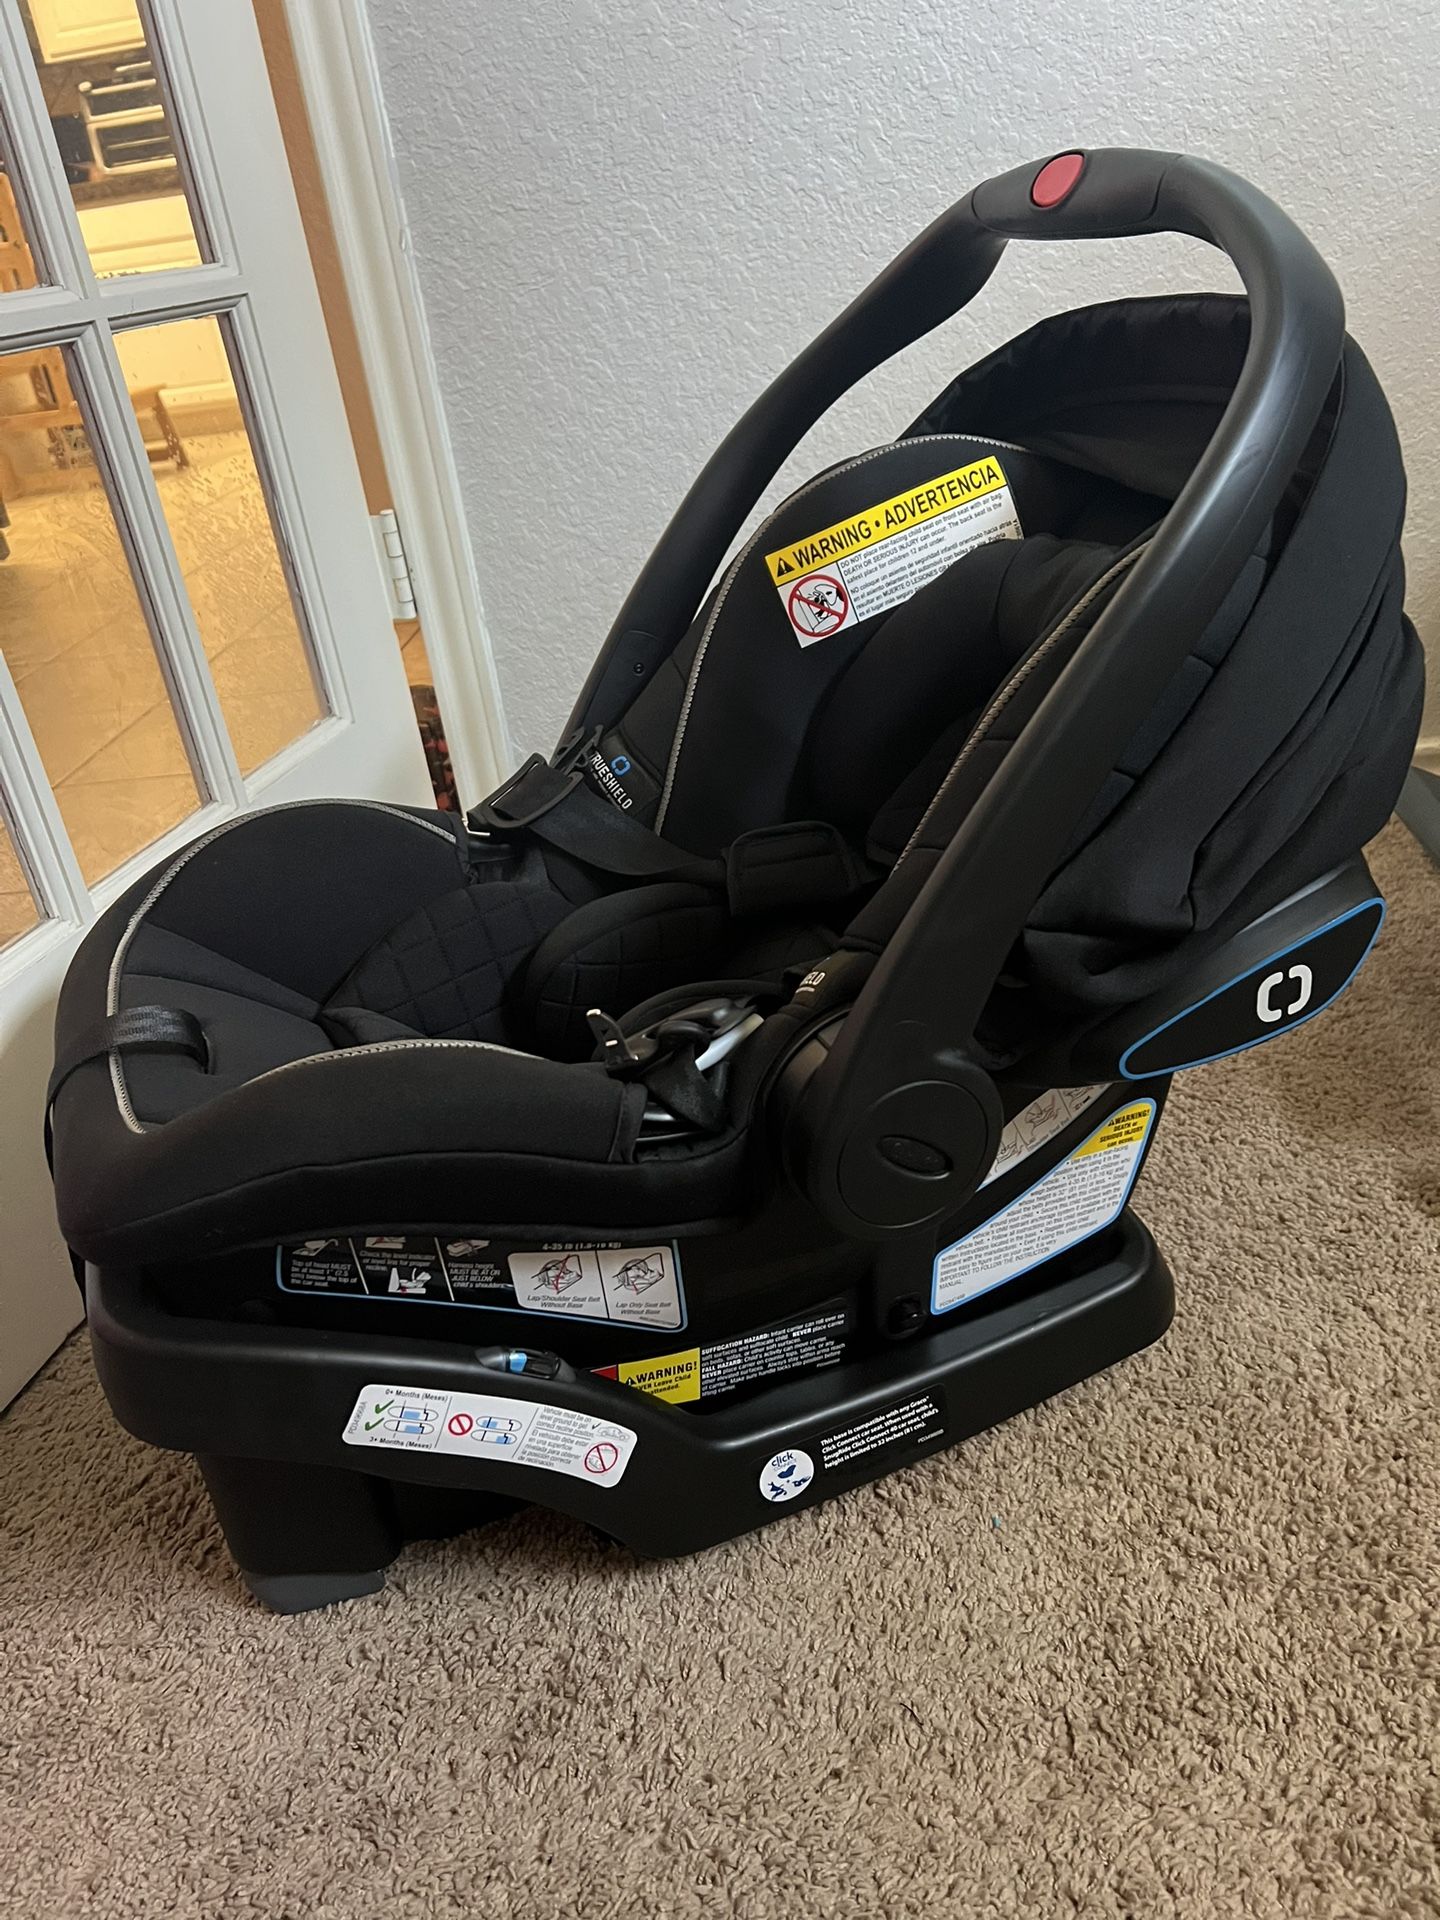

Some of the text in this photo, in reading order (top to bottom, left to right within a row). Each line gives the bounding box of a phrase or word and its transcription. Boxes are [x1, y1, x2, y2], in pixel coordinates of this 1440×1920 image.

[791, 463, 1000, 569] WARNING ADVERTENCIA
[840, 559, 849, 567] DO
[849, 553, 862, 563] NOT
[862, 546, 878, 559] place
[907, 526, 922, 537] child
[921, 521, 934, 530] seat
[942, 511, 956, 521] front
[956, 505, 969, 515] seat
[969, 500, 981, 510] with
[981, 496, 990, 504] air
[843, 562, 863, 576] DEATH
[862, 558, 872, 567] OR
[872, 547, 897, 562] SERIOUS
[898, 537, 919, 551] INJURY
[919, 533, 930, 541] can
[948, 520, 959, 529] The
[958, 513, 973, 524] back
[973, 508, 986, 518] seat
[992, 501, 1002, 509] the
[846, 571, 863, 583] safest
[863, 565, 878, 577] place
[878, 561, 887, 569] for
[886, 551, 909, 565] children
[909, 547, 917, 555] 12
[917, 542, 928, 551] and
[850, 586, 859, 594] NO
[881, 583, 905, 597] MUERTE
[910, 568, 938, 584] LESIONES
[1113, 1109, 1150, 1125] WARNING!
[701, 1339, 742, 1355] SUFFOCATION
[744, 1331, 769, 1343] HAZARD:
[792, 1327, 811, 1337] NEVER
[636, 1360, 696, 1383] WARNING!
[701, 1364, 715, 1373] FALL
[717, 1357, 742, 1369] HAZARD:
[701, 1369, 721, 1379] NEVER
[638, 1373, 690, 1390] VER Leave Child
[651, 1382, 679, 1393] attended.
[395, 1390, 421, 1398] Months
[421, 1393, 448, 1402] (Meses)
[820, 1436, 833, 1446] This
[833, 1430, 847, 1440] base
[853, 1414, 885, 1433] compatible
[885, 1408, 899, 1418] with
[898, 1404, 910, 1414] any
[821, 1443, 836, 1454] Click
[836, 1433, 860, 1447] Connect
[883, 1415, 901, 1427] When
[900, 1409, 915, 1420] used
[915, 1403, 928, 1413] with
[379, 1437, 404, 1446] Months
[404, 1441, 432, 1451] (Meses)
[823, 1445, 851, 1462] SnugRide
[851, 1438, 865, 1449] Click
[865, 1428, 889, 1443] Connect
[897, 1421, 906, 1429] car
[824, 1456, 844, 1469] height
[849, 1444, 870, 1458] limited
[870, 1441, 877, 1449] to
[885, 1430, 903, 1442] inches
[771, 1452, 793, 1467] click
